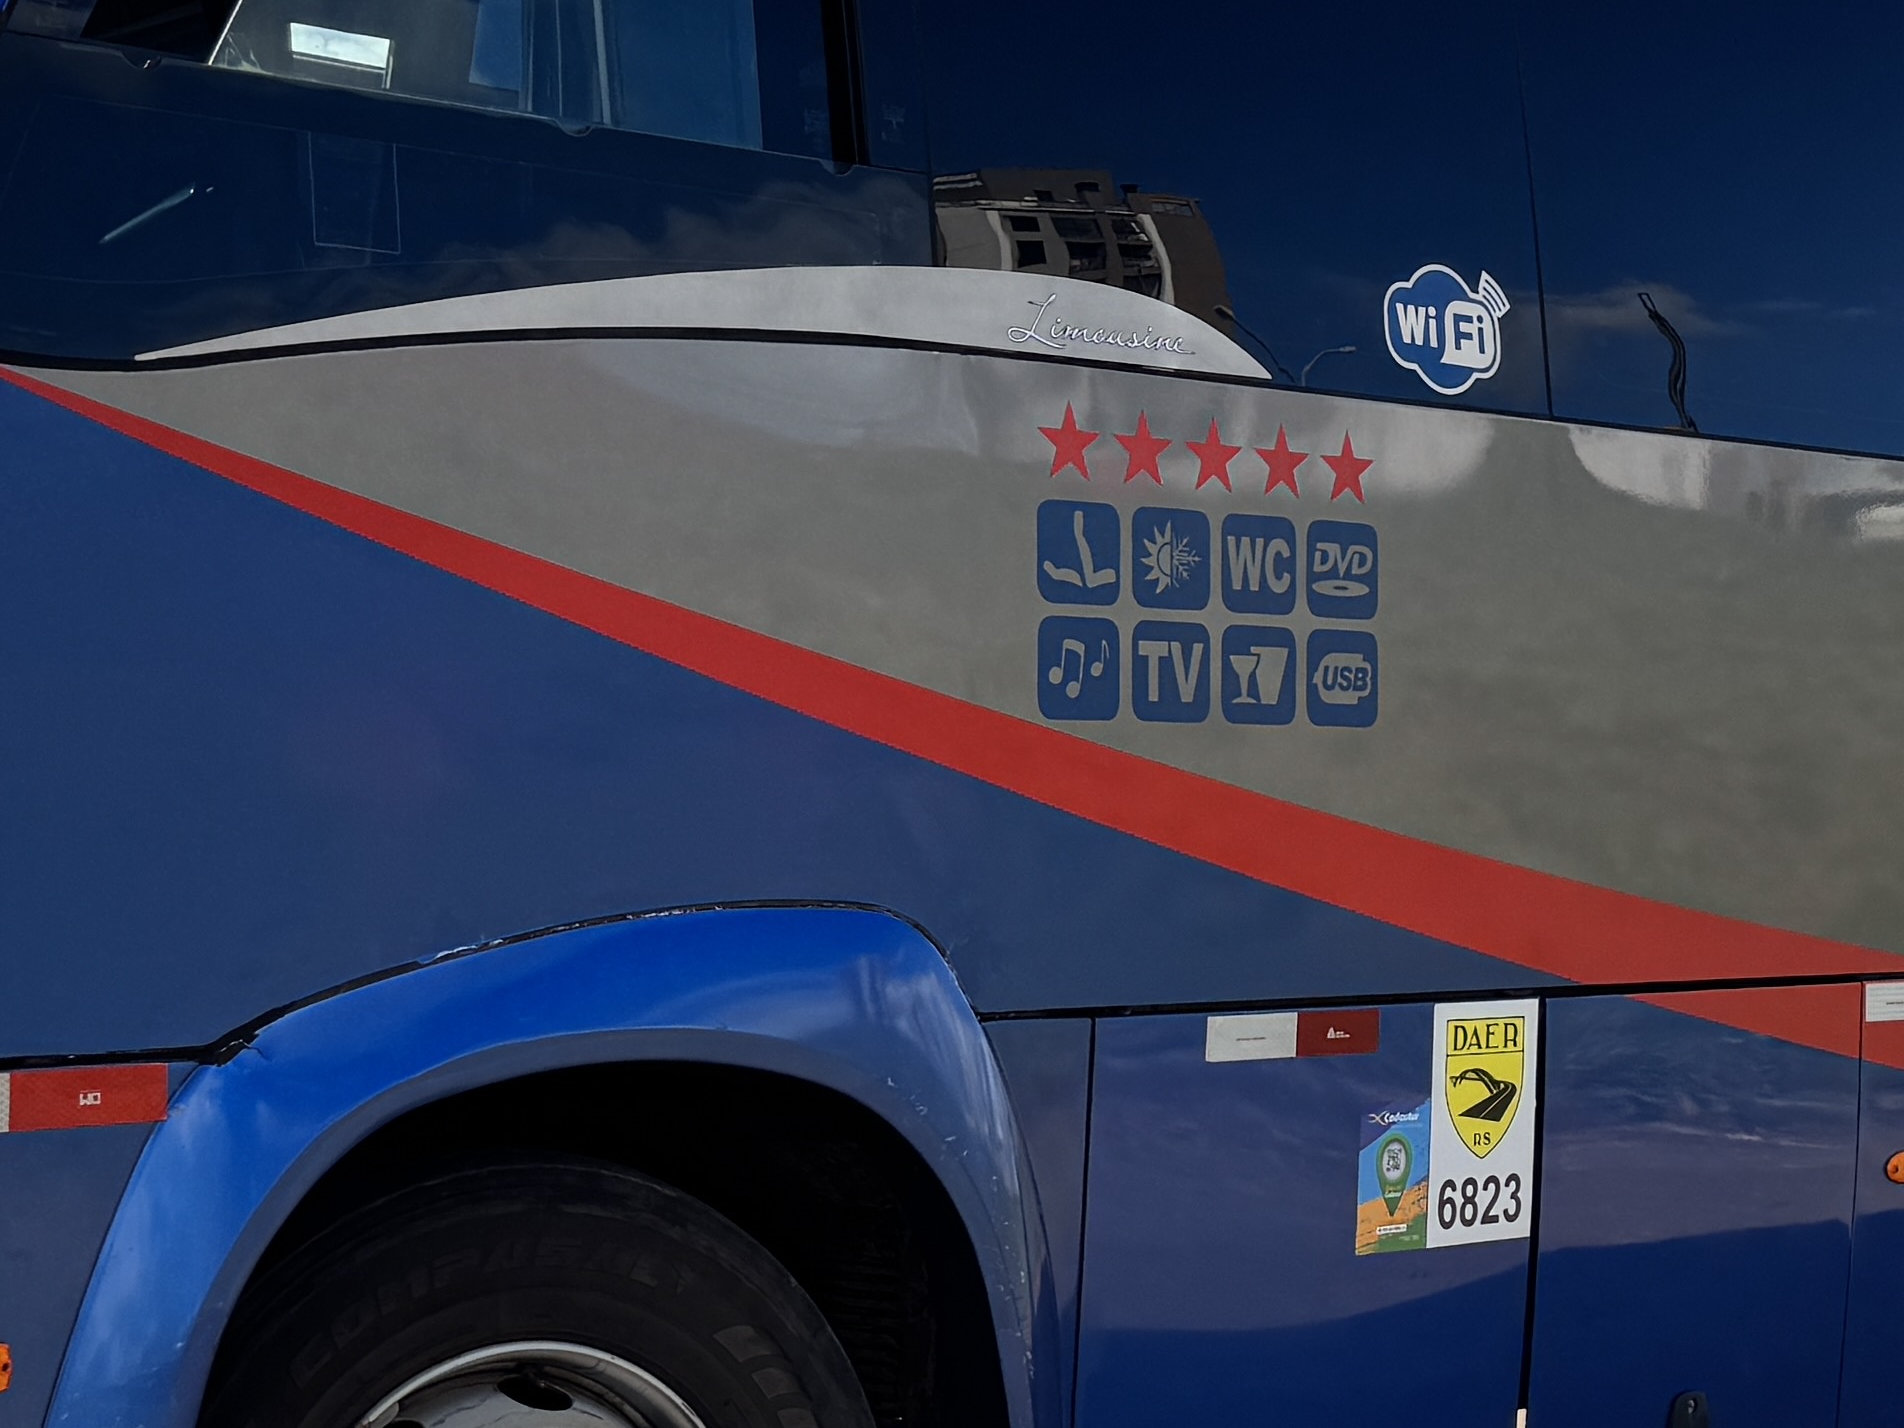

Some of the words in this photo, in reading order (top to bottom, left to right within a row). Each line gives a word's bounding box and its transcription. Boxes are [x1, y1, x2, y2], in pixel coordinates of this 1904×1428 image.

[1007, 293, 1196, 355] Limousine
[1227, 534, 1292, 595] WC
[1314, 542, 1374, 578] DVD
[1139, 639, 1204, 703] TV
[1322, 663, 1370, 693] USB
[1452, 1022, 1520, 1051] DAER
[1473, 1132, 1492, 1147] RS
[1437, 1173, 1523, 1231] 6823
